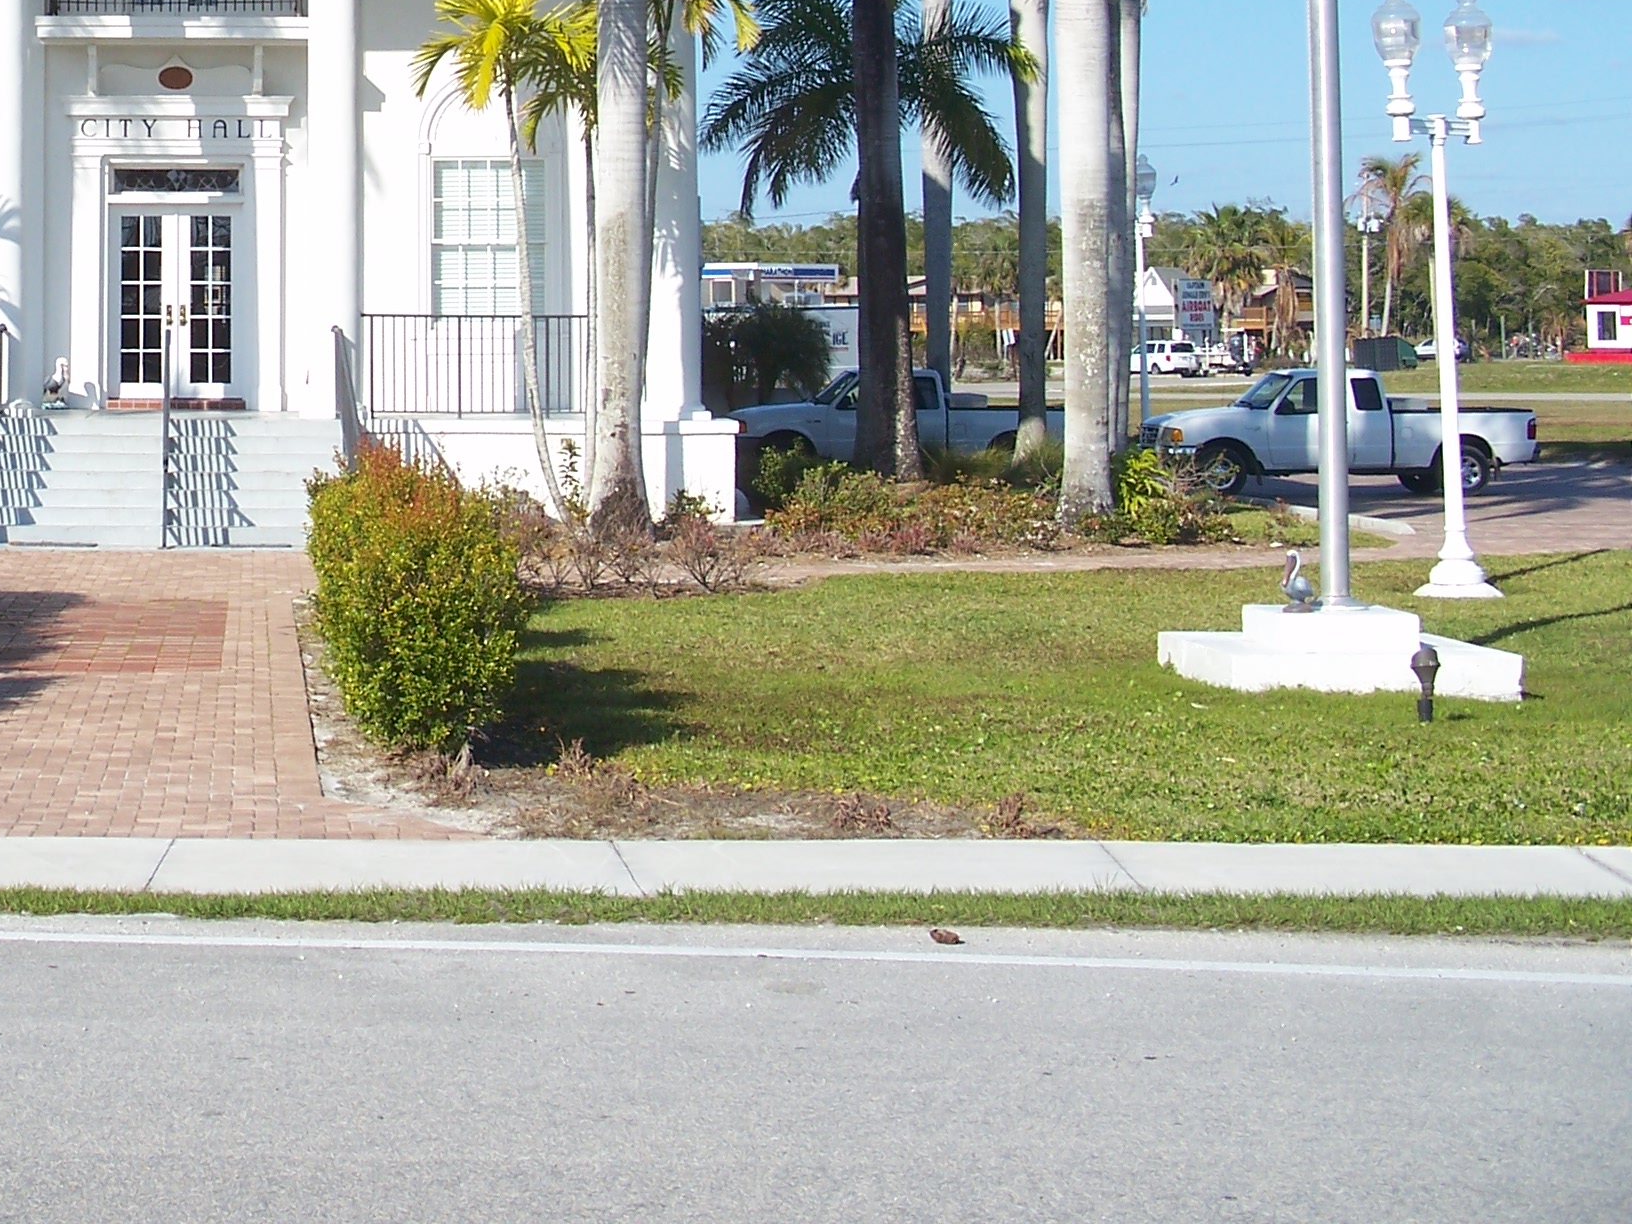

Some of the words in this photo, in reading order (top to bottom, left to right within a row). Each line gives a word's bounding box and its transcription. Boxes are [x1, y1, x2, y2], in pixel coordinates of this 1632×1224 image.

[80, 118, 158, 138] CITY
[186, 119, 273, 138] HALL
[1182, 300, 1211, 312] AIRBOAT
